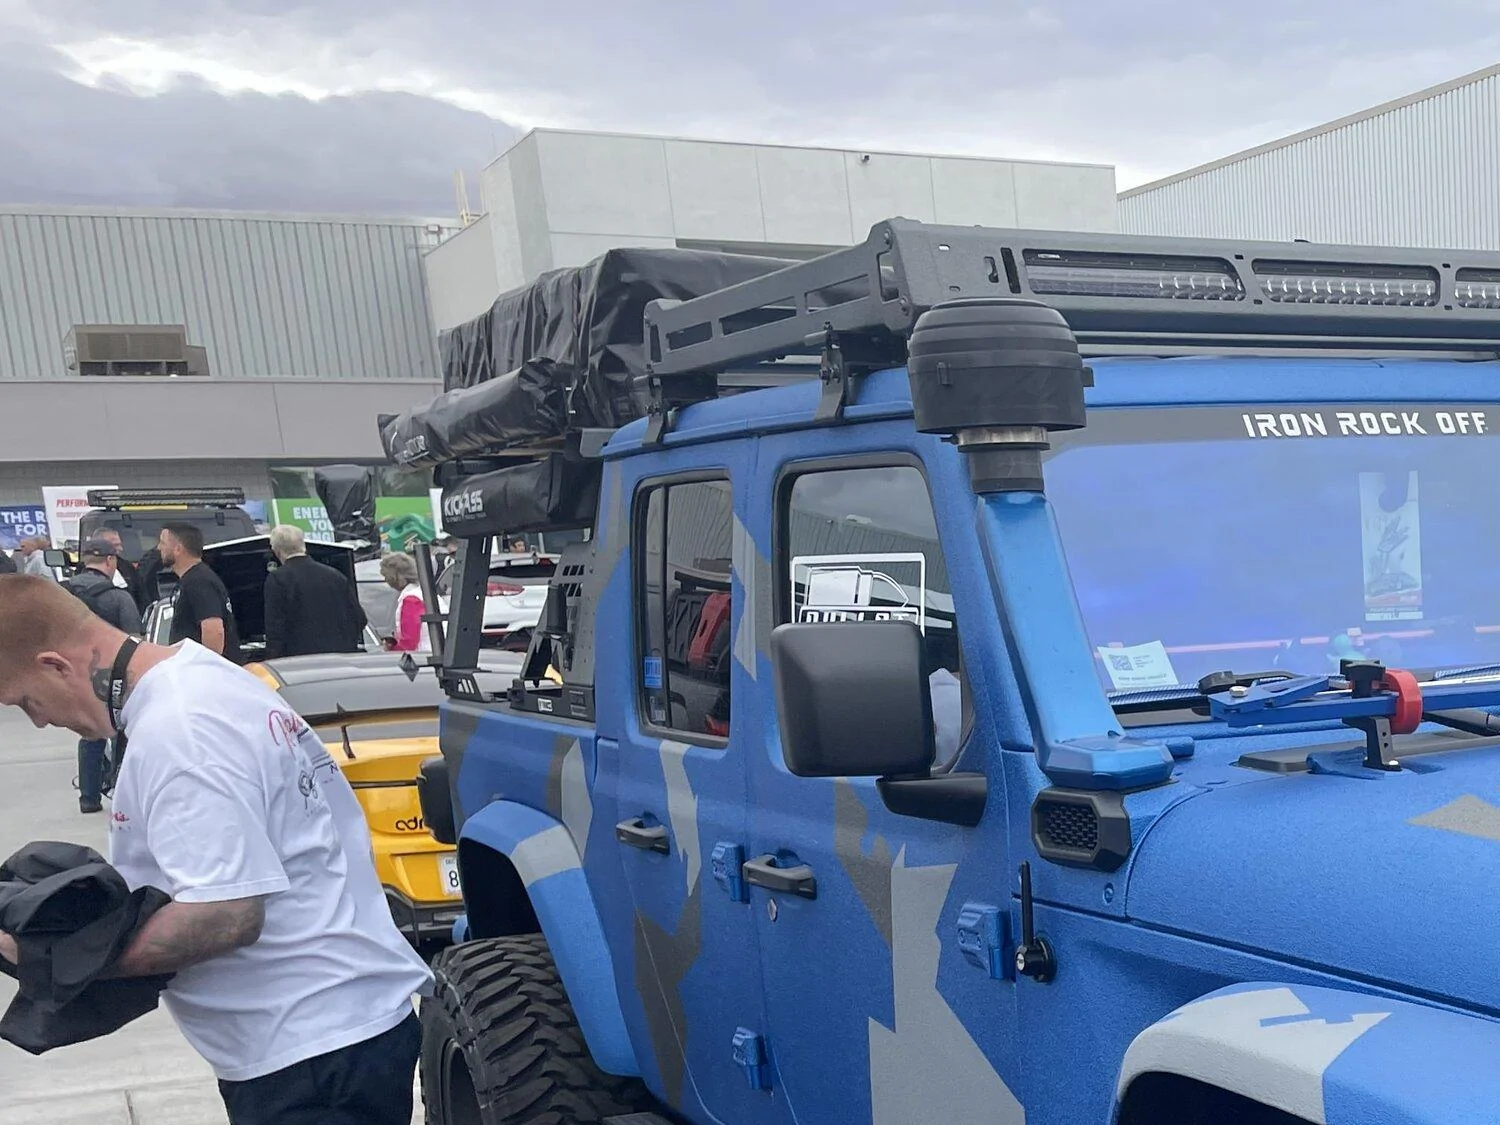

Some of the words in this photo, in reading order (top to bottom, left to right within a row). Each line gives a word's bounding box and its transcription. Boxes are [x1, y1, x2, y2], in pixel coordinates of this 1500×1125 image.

[1242, 412, 1328, 438] IRON
[1336, 412, 1427, 436] ROCK
[1436, 411, 1488, 435] OFF
[1, 511, 30, 523] THE
[15, 523, 48, 536] FOR
